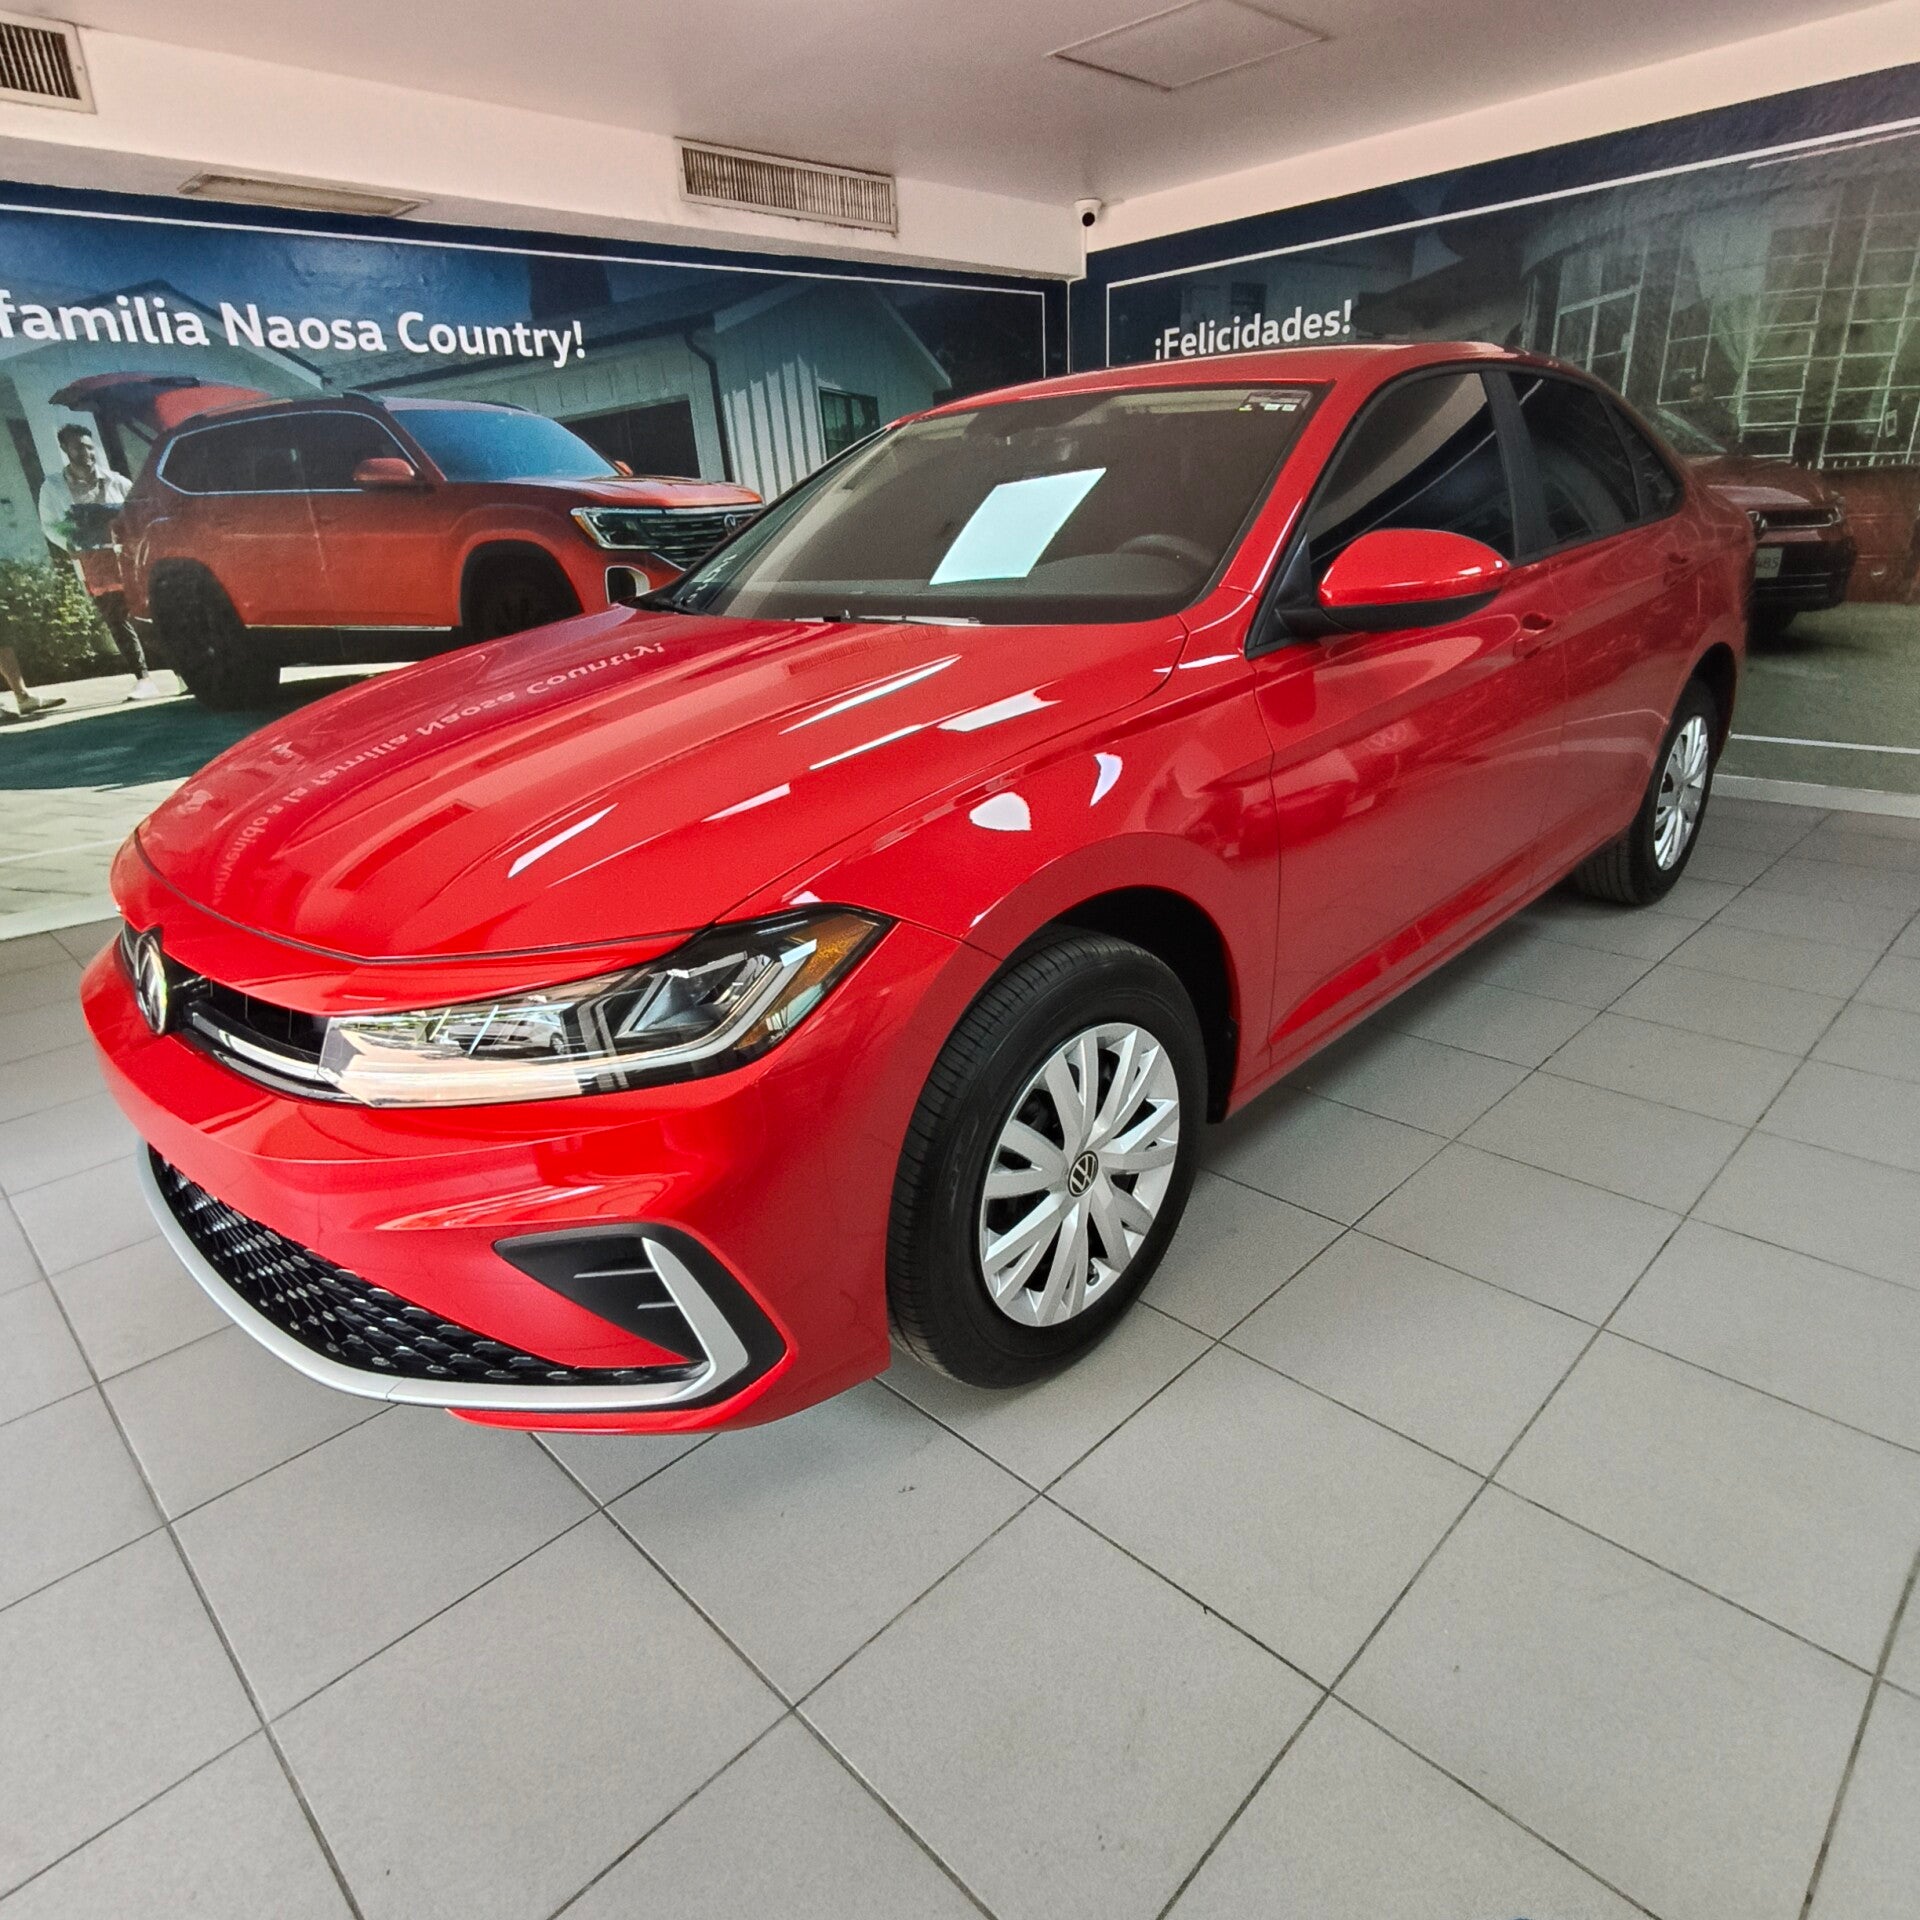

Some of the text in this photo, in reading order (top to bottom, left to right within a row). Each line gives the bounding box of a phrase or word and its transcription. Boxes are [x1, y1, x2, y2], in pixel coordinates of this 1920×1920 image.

[0, 289, 587, 368] familia Naosa Country!
[1155, 299, 1352, 361] ¡Felicidades!
